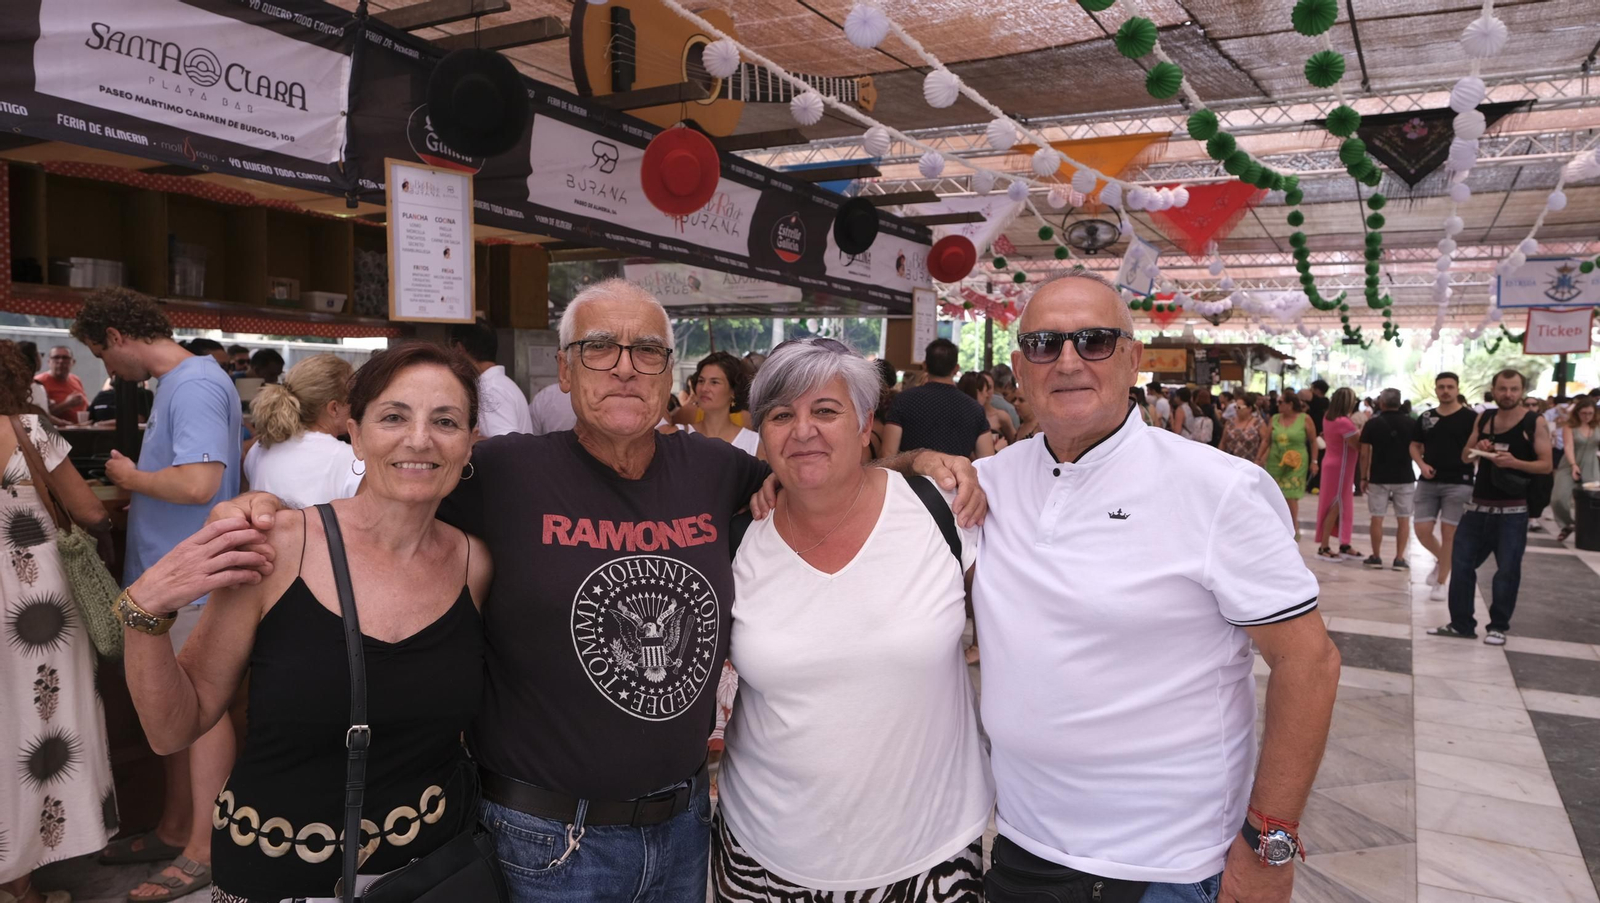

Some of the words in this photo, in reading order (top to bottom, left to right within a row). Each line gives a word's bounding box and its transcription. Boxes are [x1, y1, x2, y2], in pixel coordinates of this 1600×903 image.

[262, 2, 293, 20] QUIERO
[292, 12, 312, 28] TODO
[85, 21, 183, 76] SANTA
[224, 62, 309, 112] CLARA
[148, 76, 208, 101] PLAYA
[222, 97, 253, 114] BAR
[99, 84, 134, 101] PASEO
[134, 92, 184, 114] MARTIMO
[185, 108, 227, 126] CARMEN
[228, 119, 239, 129] DE
[240, 122, 279, 141] BURGOS,
[280, 134, 296, 143] 108
[57, 113, 87, 132] FERIA
[88, 122, 103, 136] DE
[104, 126, 149, 146] ALMERIA
[228, 157, 241, 168] YO
[242, 160, 274, 175] QUIERO
[274, 166, 296, 179] TODO
[566, 174, 628, 204] BURANA
[402, 212, 428, 222] PLANCHA
[434, 216, 456, 225] COCINA
[778, 222, 802, 241] Estrella
[776, 236, 800, 252] Galicia
[413, 264, 430, 272] FRITOS
[906, 268, 932, 284] BURA
[542, 512, 718, 552] RAMONES
[598, 559, 694, 590] JOHNNY
[694, 590, 717, 648] JOEY
[575, 591, 621, 695] TOMMY
[630, 662, 708, 716] DEEDEE
